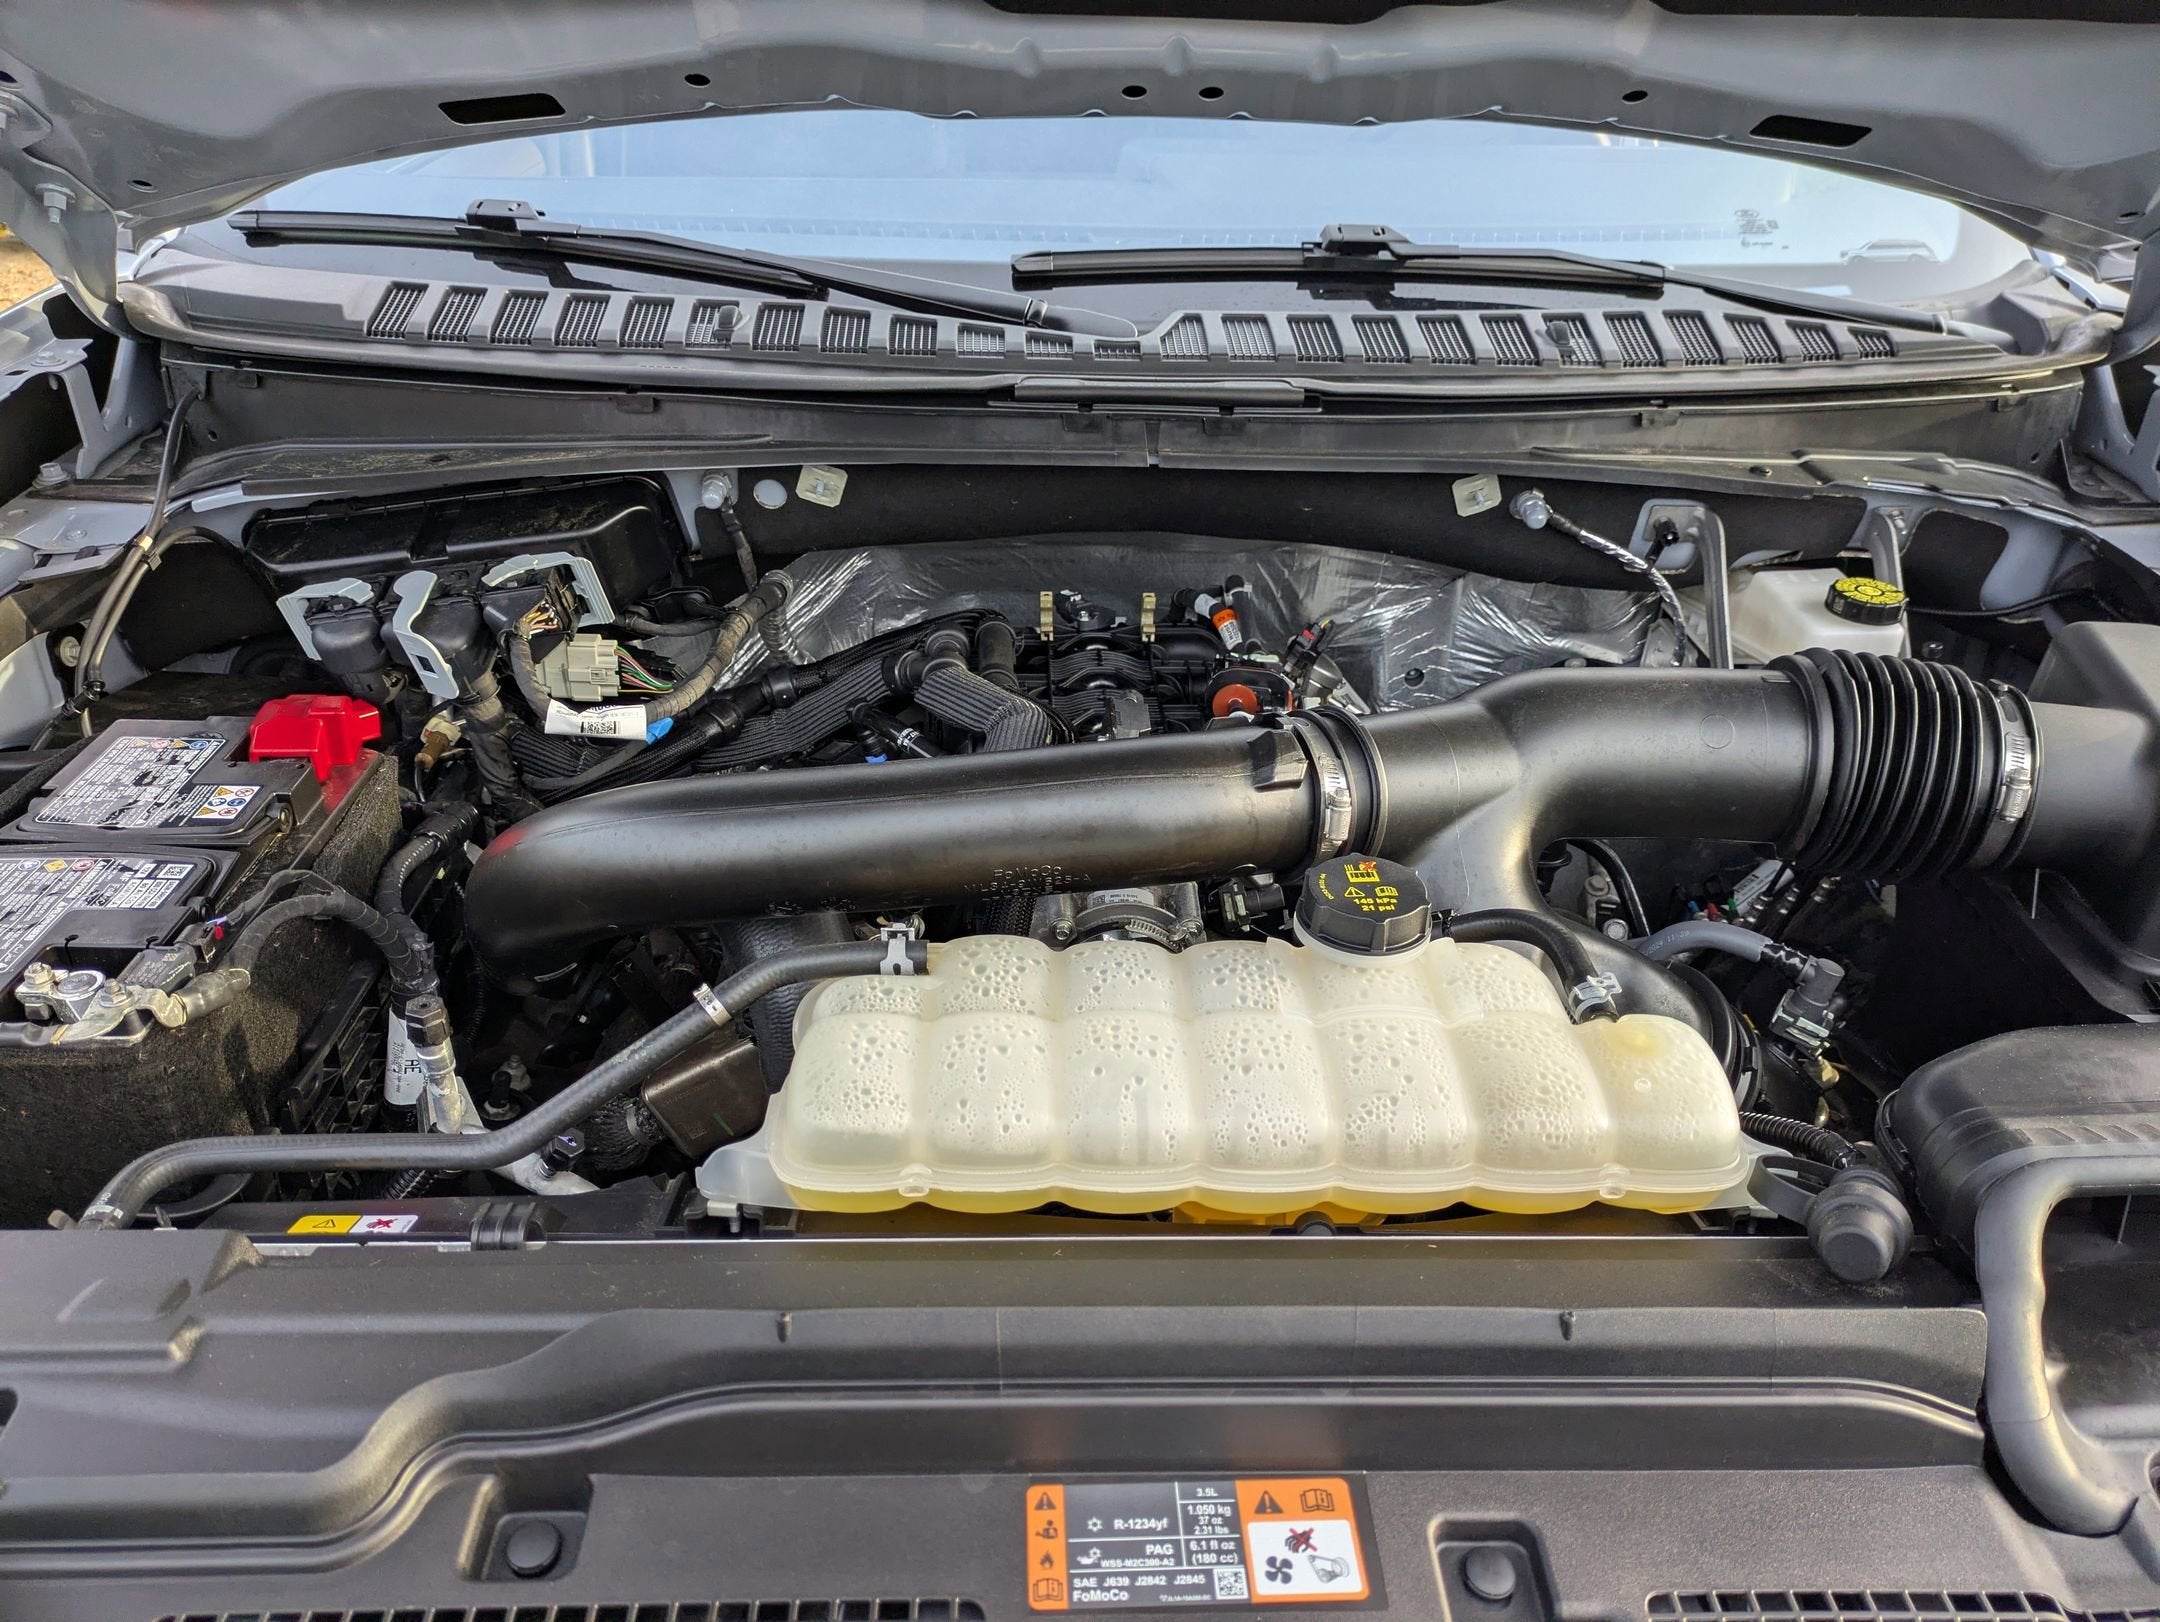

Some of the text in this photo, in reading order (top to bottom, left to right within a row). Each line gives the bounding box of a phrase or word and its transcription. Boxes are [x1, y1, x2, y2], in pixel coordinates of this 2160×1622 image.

[994, 864, 1061, 879] FoMoCo
[404, 1059, 421, 1075] AE
[1196, 1487, 1218, 1497] 3.5L
[1187, 1504, 1232, 1517] 1.050 kg
[1113, 1517, 1168, 1531] R-1234yf
[1198, 1516, 1223, 1525] 37 oz
[1194, 1525, 1229, 1535] 2.31 lbs
[1145, 1543, 1174, 1555] PAG
[1190, 1540, 1236, 1551] 6.1 fl oz
[1192, 1552, 1238, 1566] (180 cc)
[1073, 1577, 1098, 1588] SAE
[1103, 1576, 1130, 1587] J639
[1072, 1588, 1129, 1602] FoMoCo
